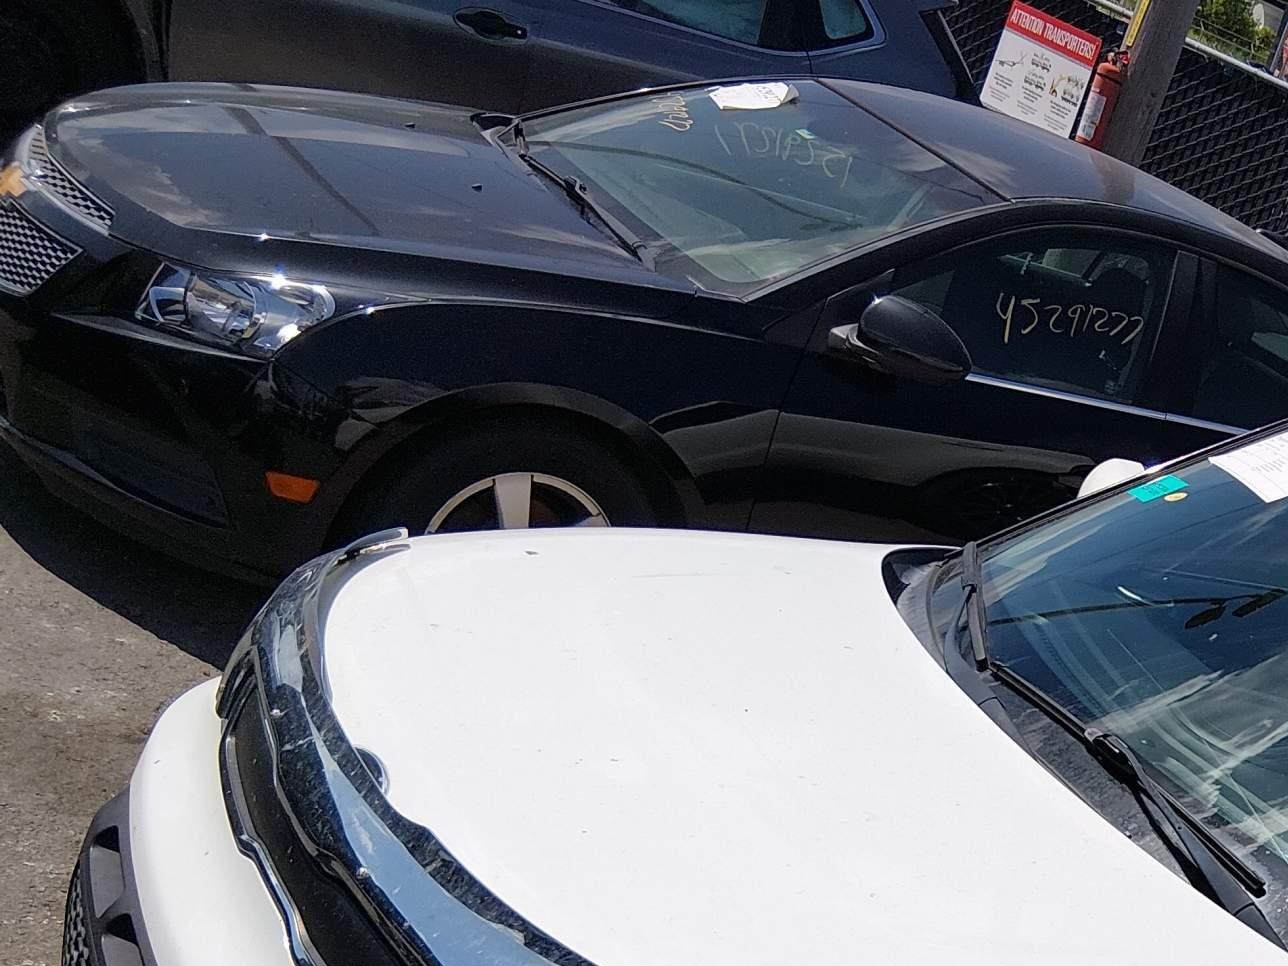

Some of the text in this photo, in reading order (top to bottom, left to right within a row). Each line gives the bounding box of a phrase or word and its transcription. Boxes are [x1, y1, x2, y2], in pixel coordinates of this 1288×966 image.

[1010, 8, 1097, 60] ATTENTION TRANSPORTERS!
[996, 292, 1144, 345] 45291277
